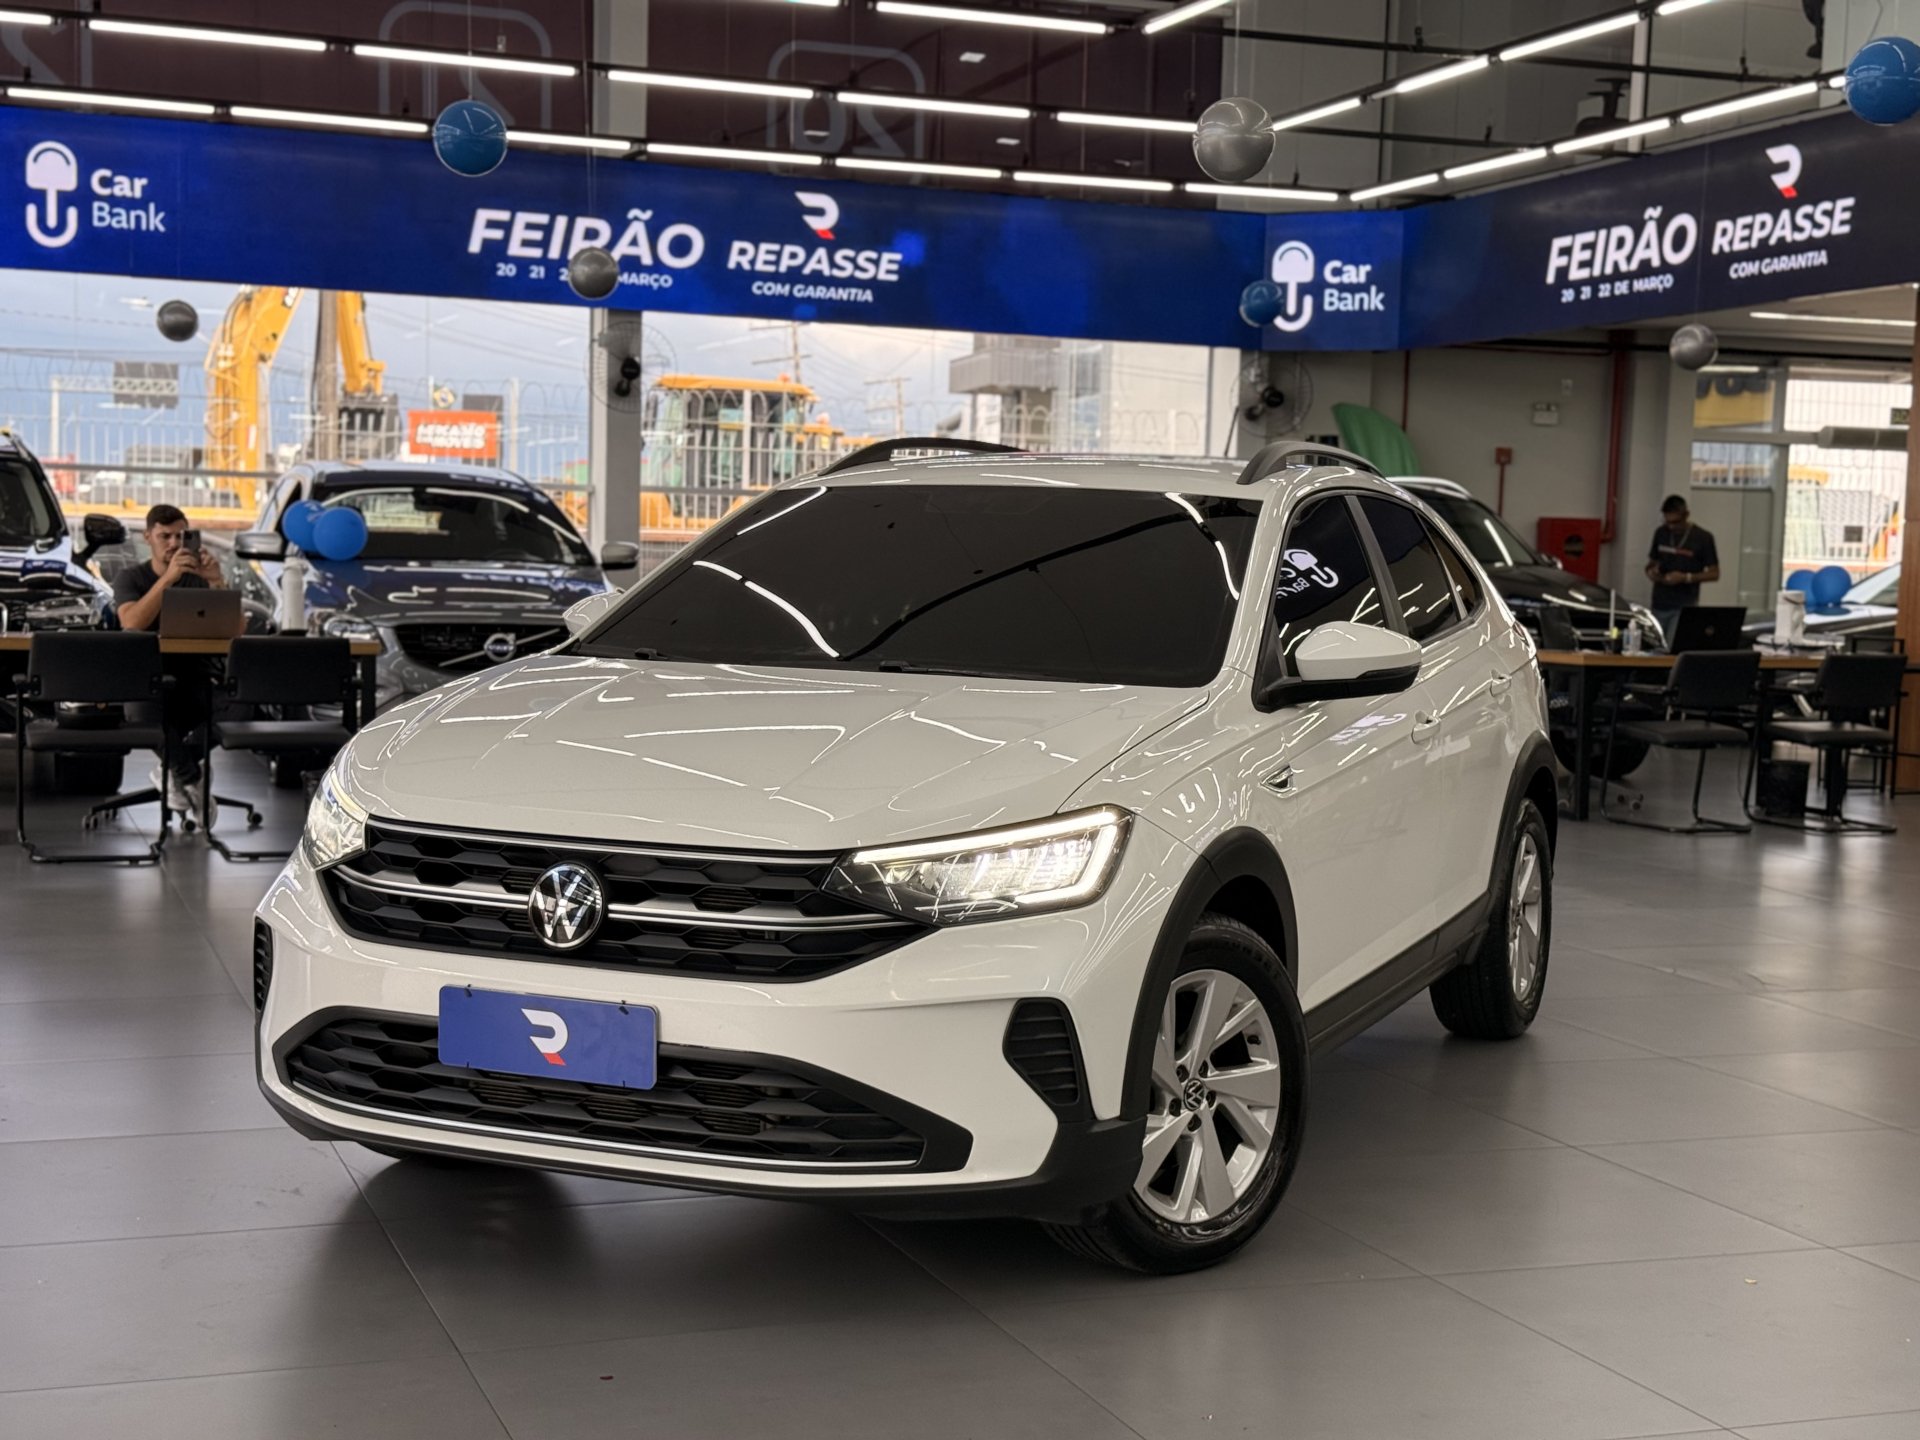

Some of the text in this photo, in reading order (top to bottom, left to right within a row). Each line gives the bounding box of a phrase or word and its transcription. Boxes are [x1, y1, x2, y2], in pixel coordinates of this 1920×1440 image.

[90, 167, 148, 199] Car
[92, 200, 166, 233] Bank
[1711, 197, 1856, 255] REPASSE
[467, 208, 705, 269] FEIRÃO
[1545, 205, 1698, 285] FEIRÃO
[726, 240, 903, 282] REPASSE
[1323, 259, 1372, 284] Car
[1729, 250, 1828, 279] COM GARANTIA
[496, 263, 516, 277] 20
[529, 265, 545, 280] 21
[617, 271, 673, 291] MARÇO
[751, 280, 874, 303] COM GARANTIA
[1560, 273, 1674, 303] 20 21 22 DE MARÇO
[1323, 284, 1385, 312] Bank
